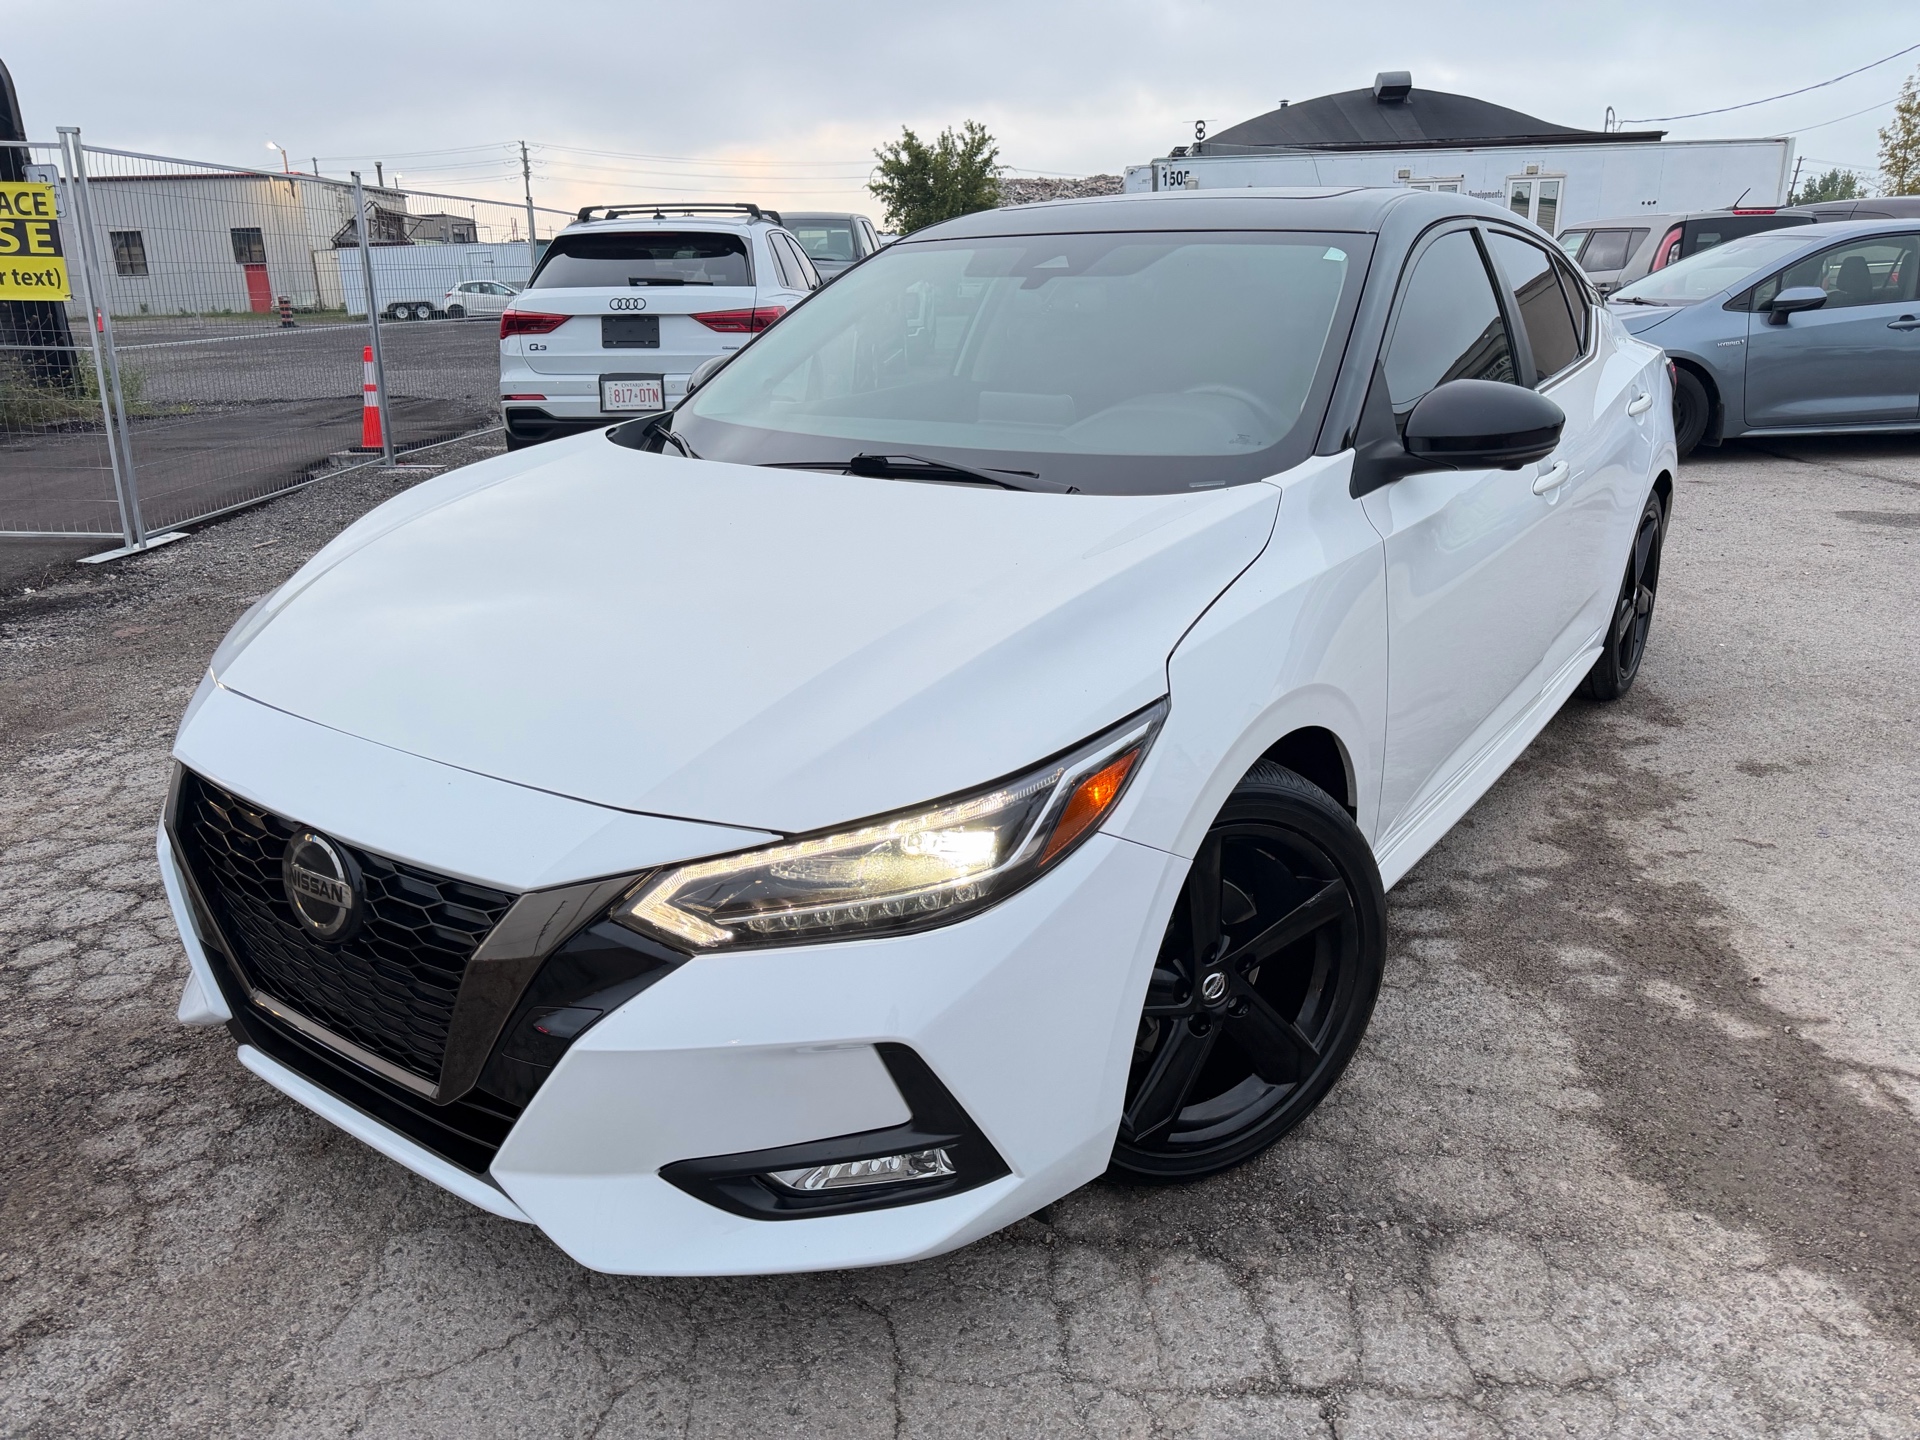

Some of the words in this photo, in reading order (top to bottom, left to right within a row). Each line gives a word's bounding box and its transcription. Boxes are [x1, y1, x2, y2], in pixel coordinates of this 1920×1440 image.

[1162, 170, 1190, 186] 1505
[11, 268, 61, 289] text)
[529, 343, 547, 351] Q3
[613, 388, 633, 403] 817
[639, 388, 659, 403] DTN
[291, 867, 343, 903] NISSAN
